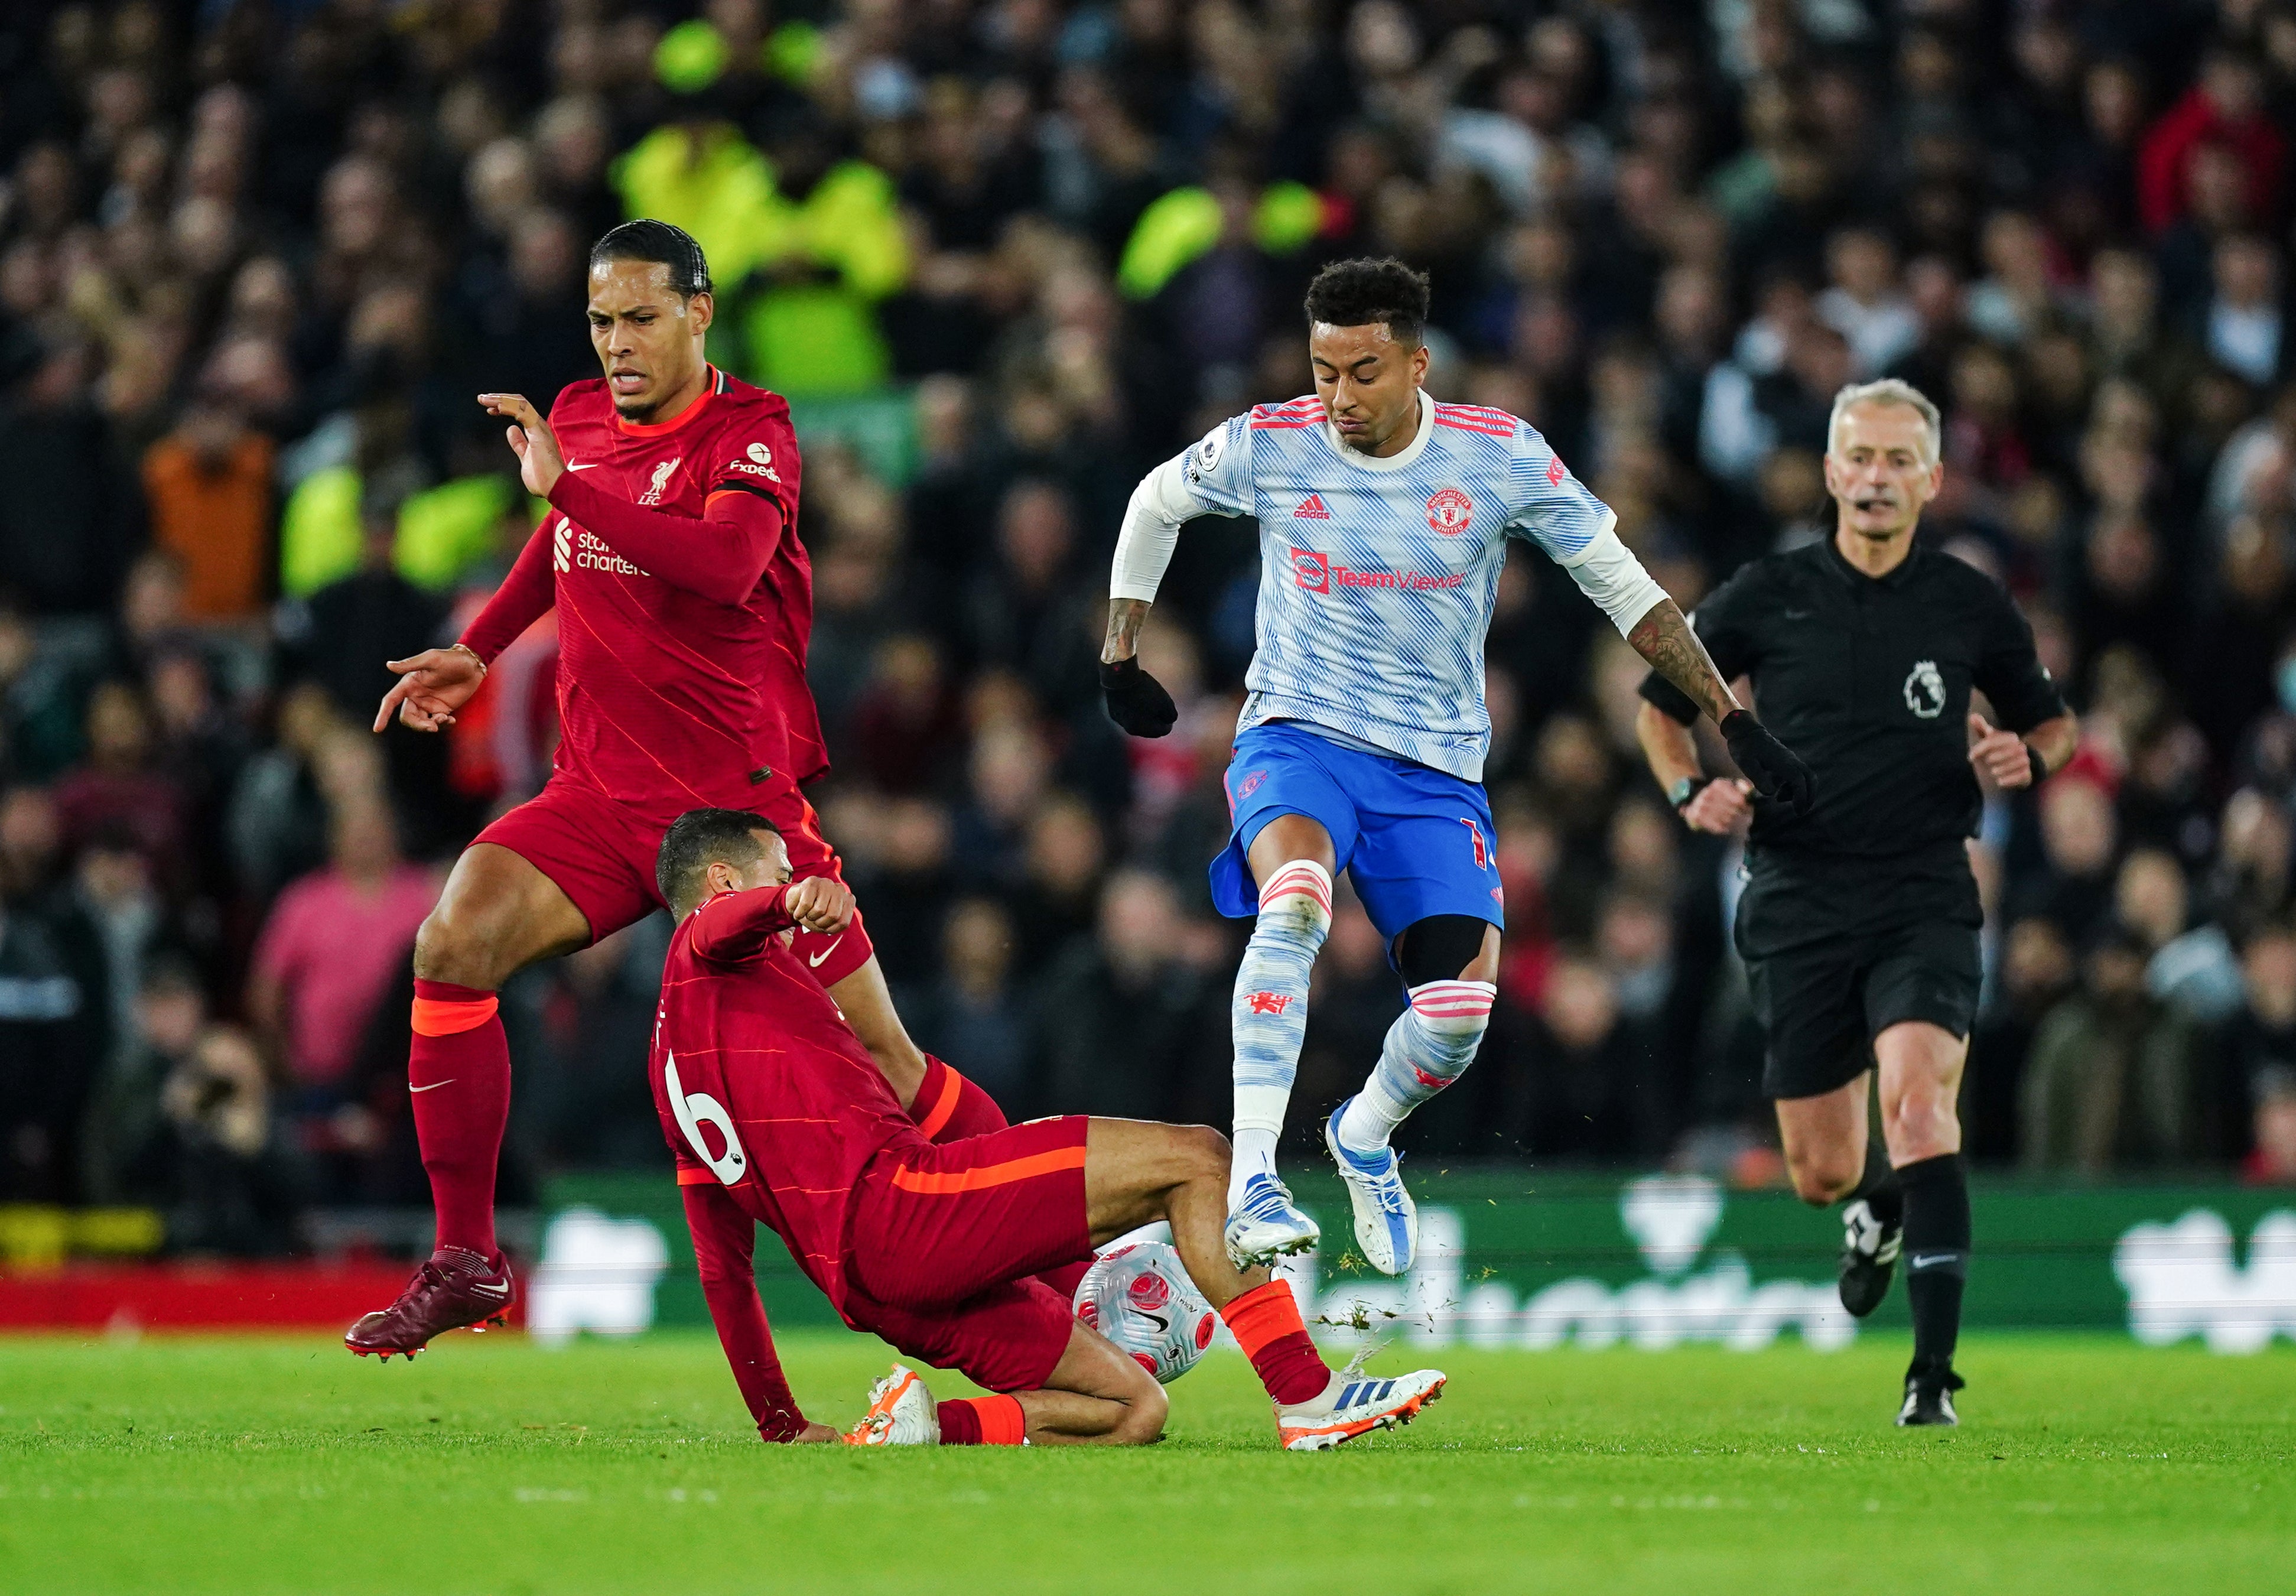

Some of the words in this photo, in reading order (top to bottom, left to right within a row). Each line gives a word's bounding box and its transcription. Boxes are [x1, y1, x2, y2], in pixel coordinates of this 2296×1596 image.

[637, 495, 661, 506] LFC
[1430, 490, 1470, 508] MANCHESTER
[1293, 510, 1329, 520] adidas
[1436, 524, 1464, 534] UNITED
[1332, 565, 1466, 591] TeamViewer
[665, 1048, 747, 1186] 6
